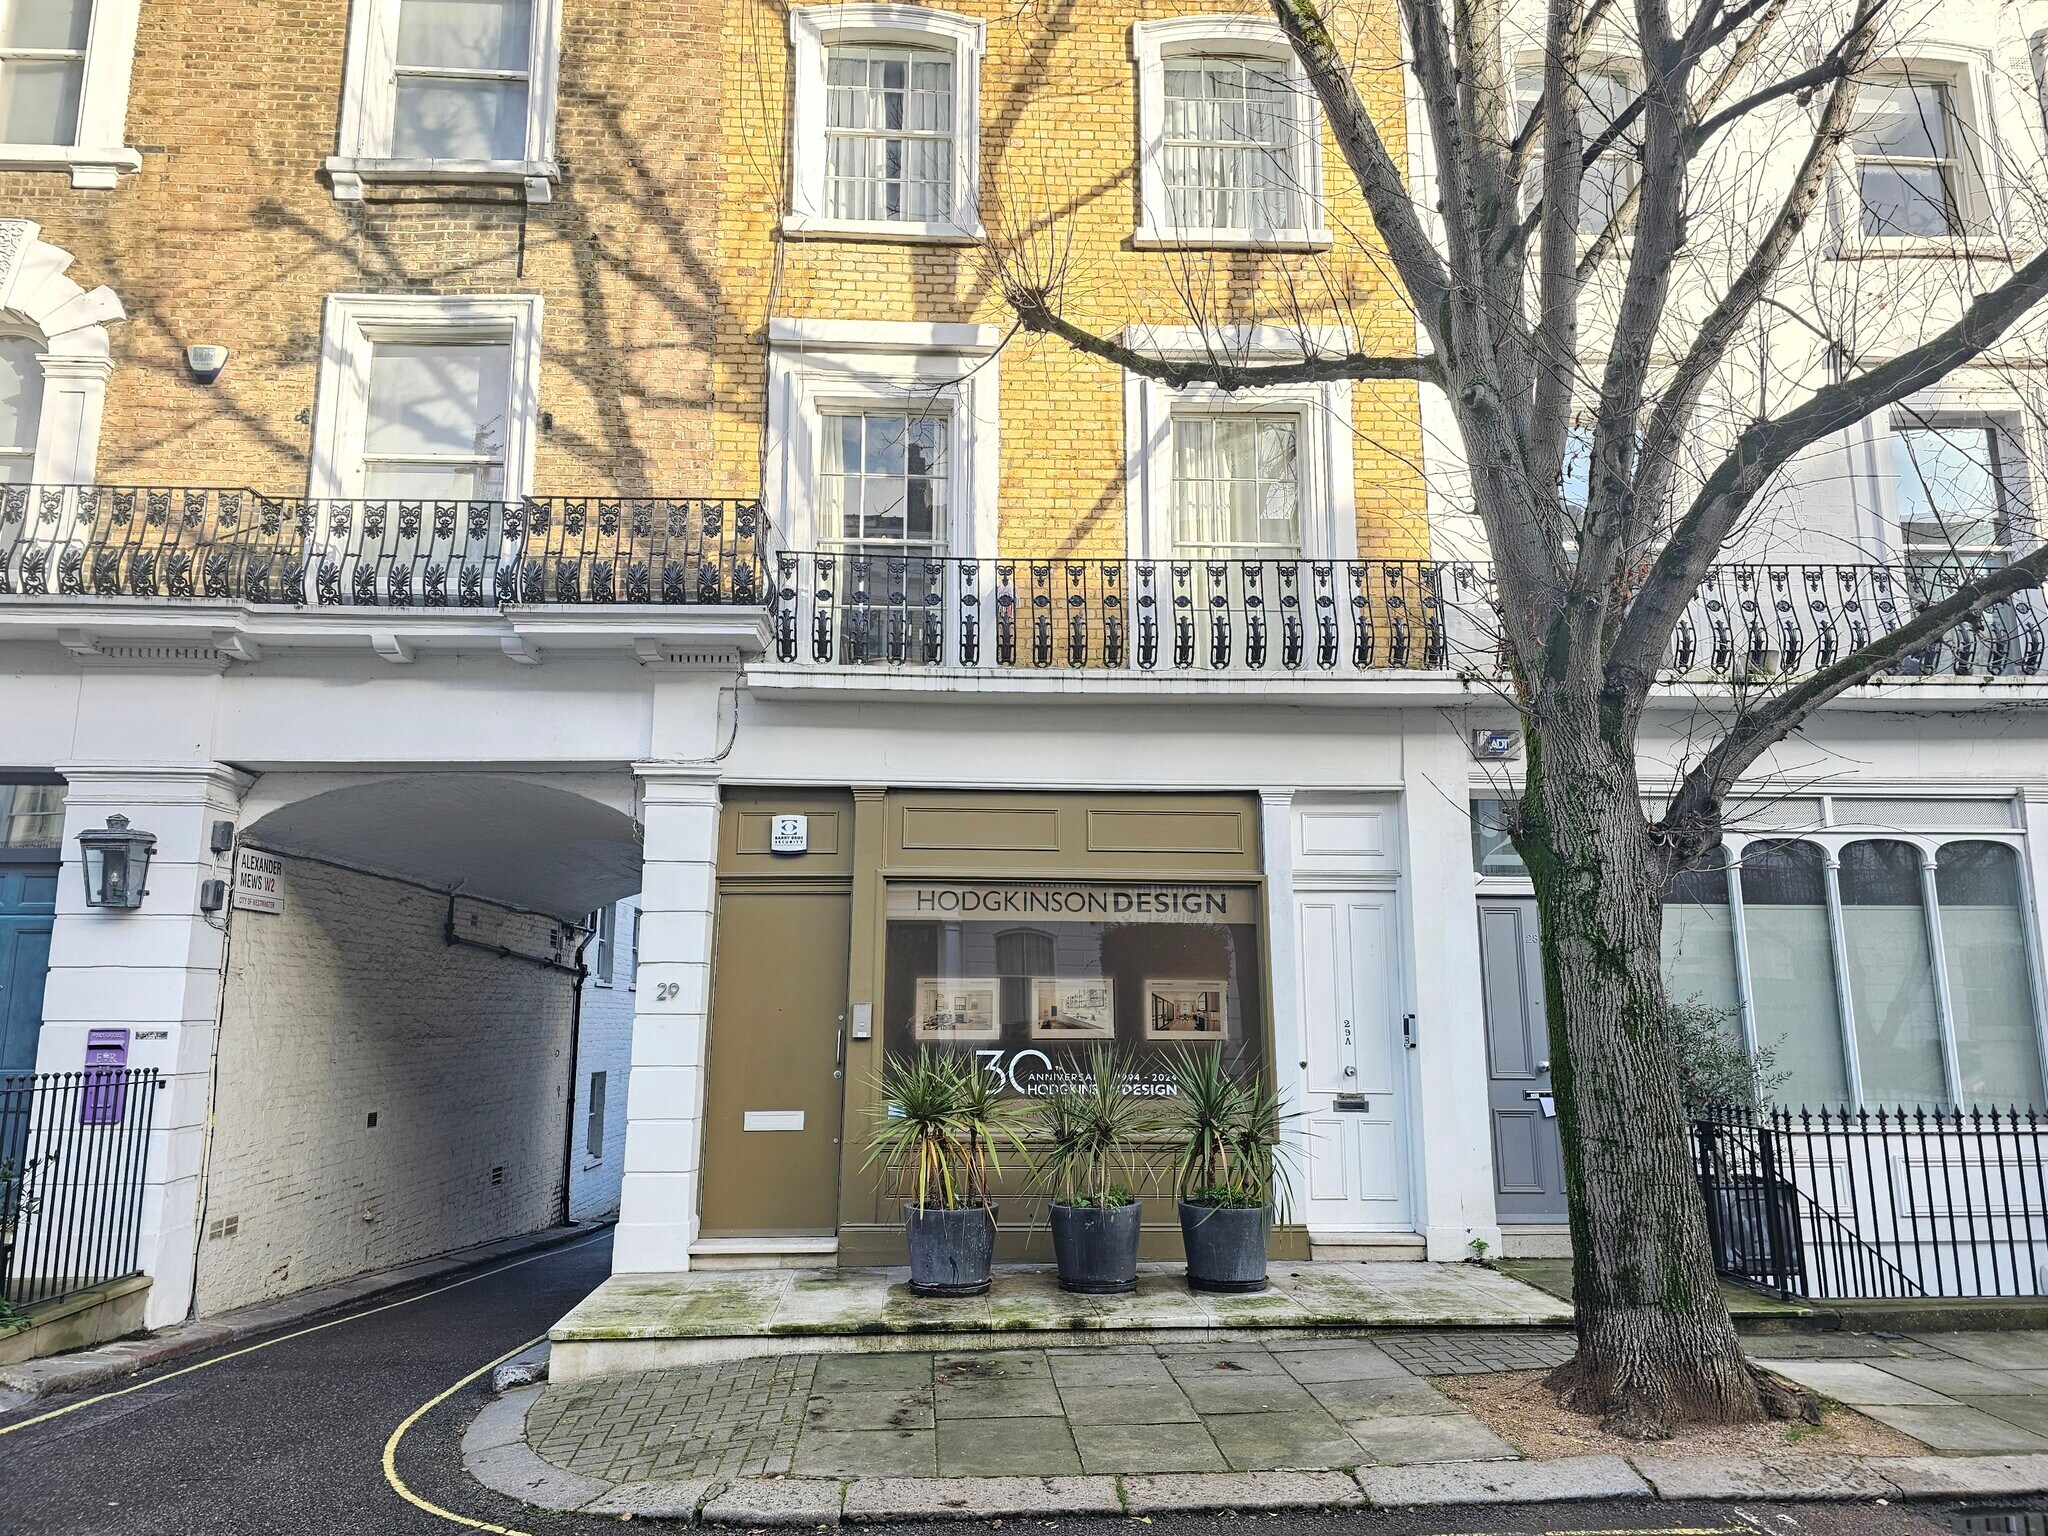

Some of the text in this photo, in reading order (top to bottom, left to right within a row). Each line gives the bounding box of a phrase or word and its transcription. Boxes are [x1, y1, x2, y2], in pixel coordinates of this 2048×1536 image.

[1491, 738, 1509, 750] ADT
[241, 853, 282, 876] ALEXANDER
[240, 872, 275, 892] MEWS W2
[253, 899, 275, 908] WESTMINSTER
[1525, 934, 1539, 944] 28
[655, 982, 680, 1001] 29
[1028, 1073, 1105, 1081] ANNIVERSA
[1152, 1073, 1177, 1082] 2024
